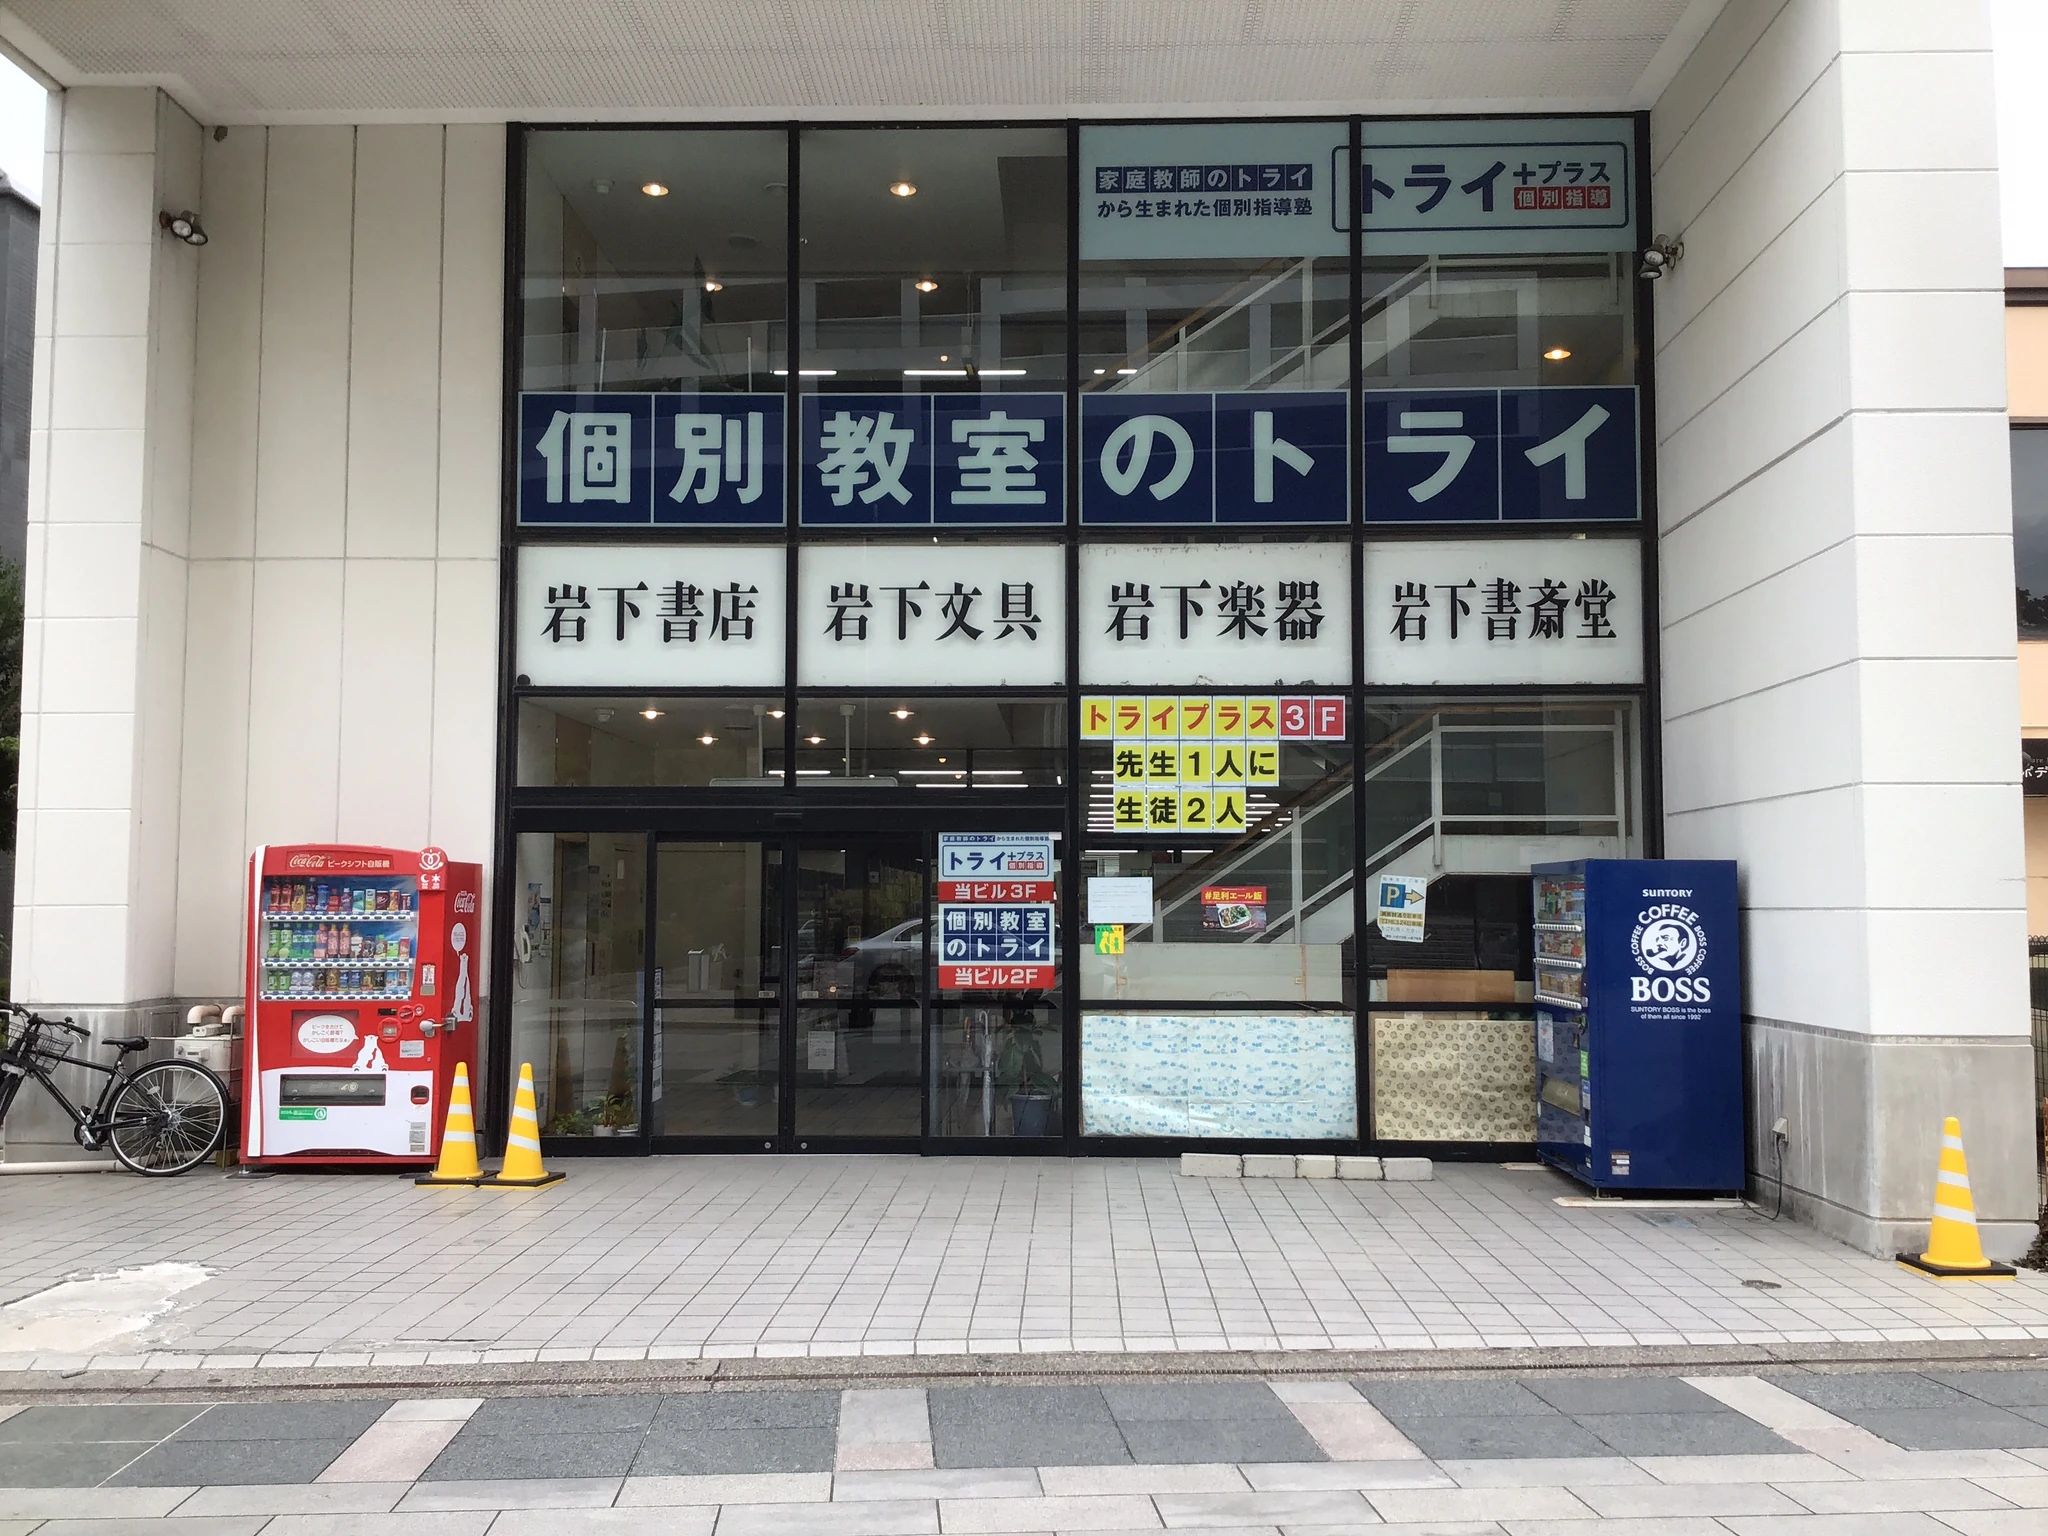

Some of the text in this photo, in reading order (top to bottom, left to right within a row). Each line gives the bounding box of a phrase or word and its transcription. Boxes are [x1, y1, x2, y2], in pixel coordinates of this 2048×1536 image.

[1097, 167, 1311, 191] 家庭教師のトライ
[1097, 198, 1313, 218] から生まれた個別指導塾
[1517, 187, 1609, 208] 個別指導
[541, 580, 759, 643] 岩下書店
[824, 580, 1042, 643] 岩下文具
[1104, 580, 1326, 642] 岩下楽器
[1390, 577, 1617, 642] 岩下書斎堂
[1116, 749, 1275, 778] 先生1人に
[1116, 796, 1244, 824] 生徒2人
[954, 883, 1037, 900] 当ビル3F
[946, 911, 1047, 931] 個別教室
[1638, 904, 1699, 926] COFFEE
[946, 938, 1046, 957] のトライ
[954, 967, 1038, 985] 当ビル2F
[1630, 976, 1711, 1002] BOSS
